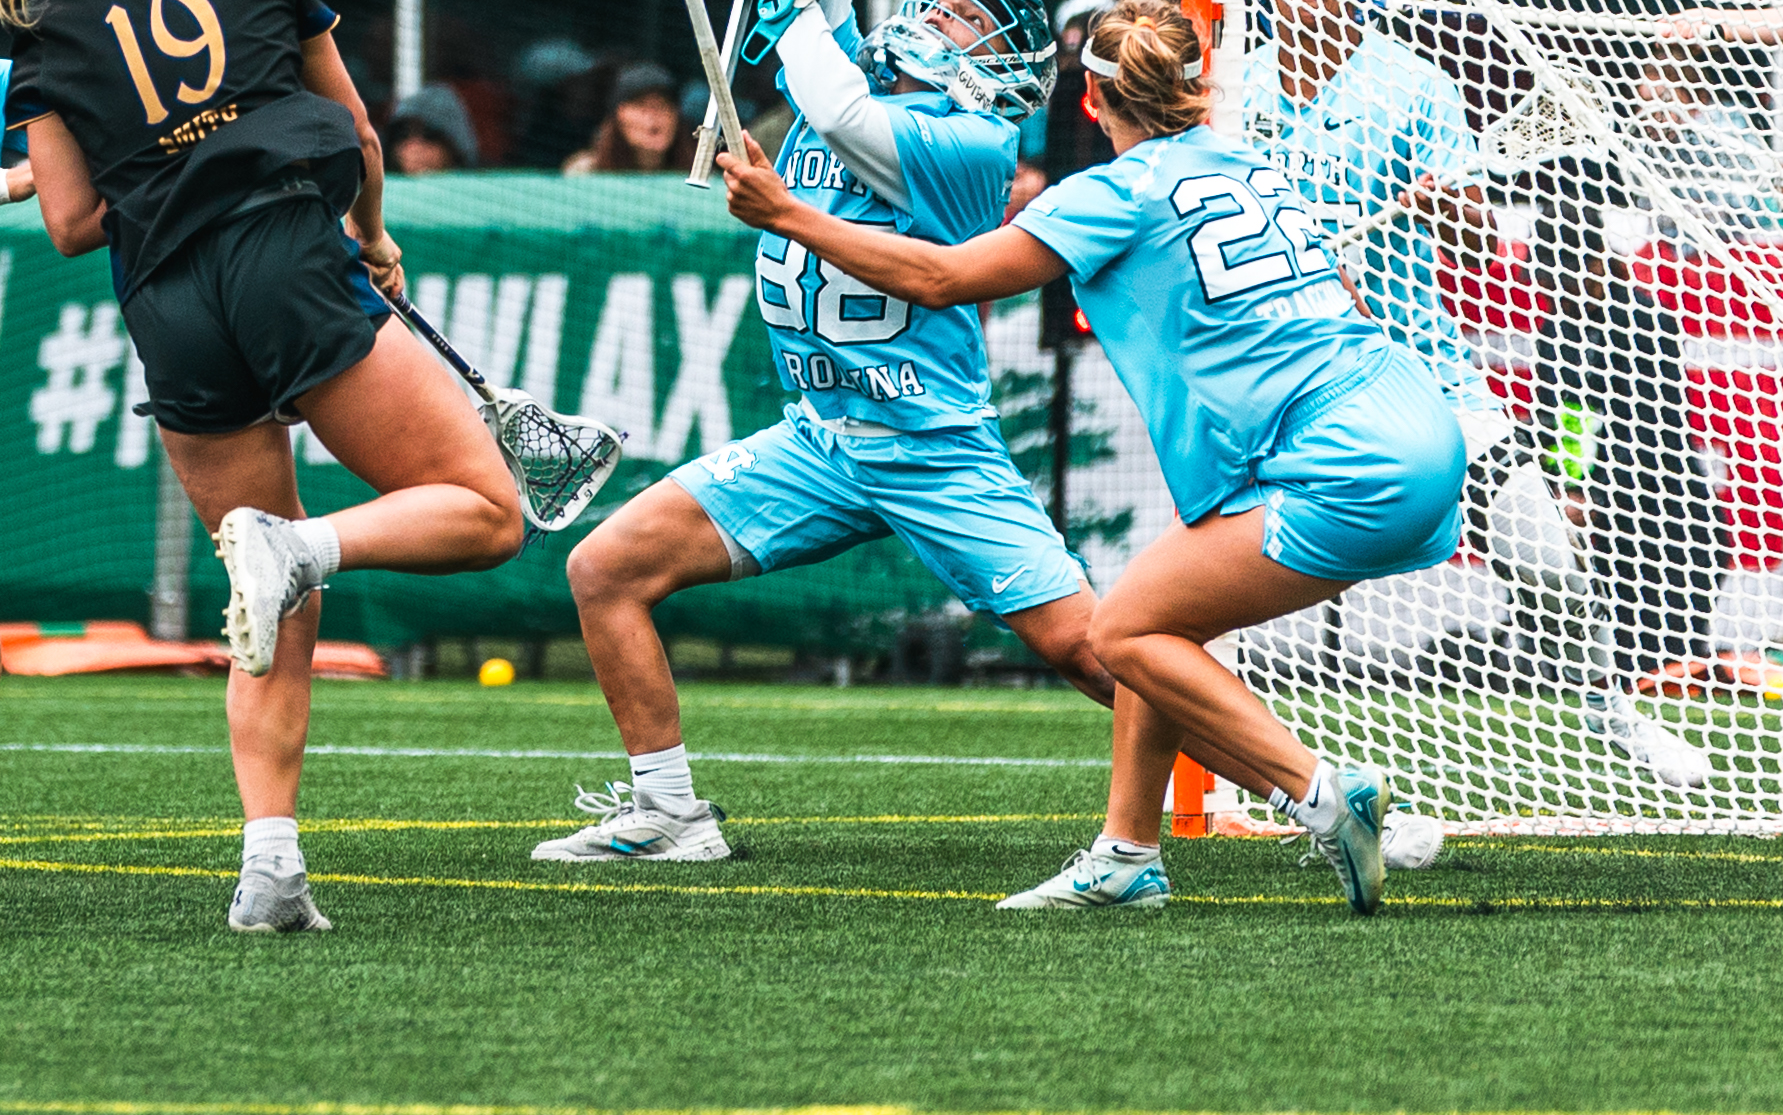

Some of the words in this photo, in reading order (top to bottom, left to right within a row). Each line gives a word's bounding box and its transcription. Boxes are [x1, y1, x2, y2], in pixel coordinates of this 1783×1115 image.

[781, 148, 892, 205] NOR
[1263, 149, 1351, 186] ORTH
[1169, 165, 1331, 306] 22
[755, 219, 913, 347] 88
